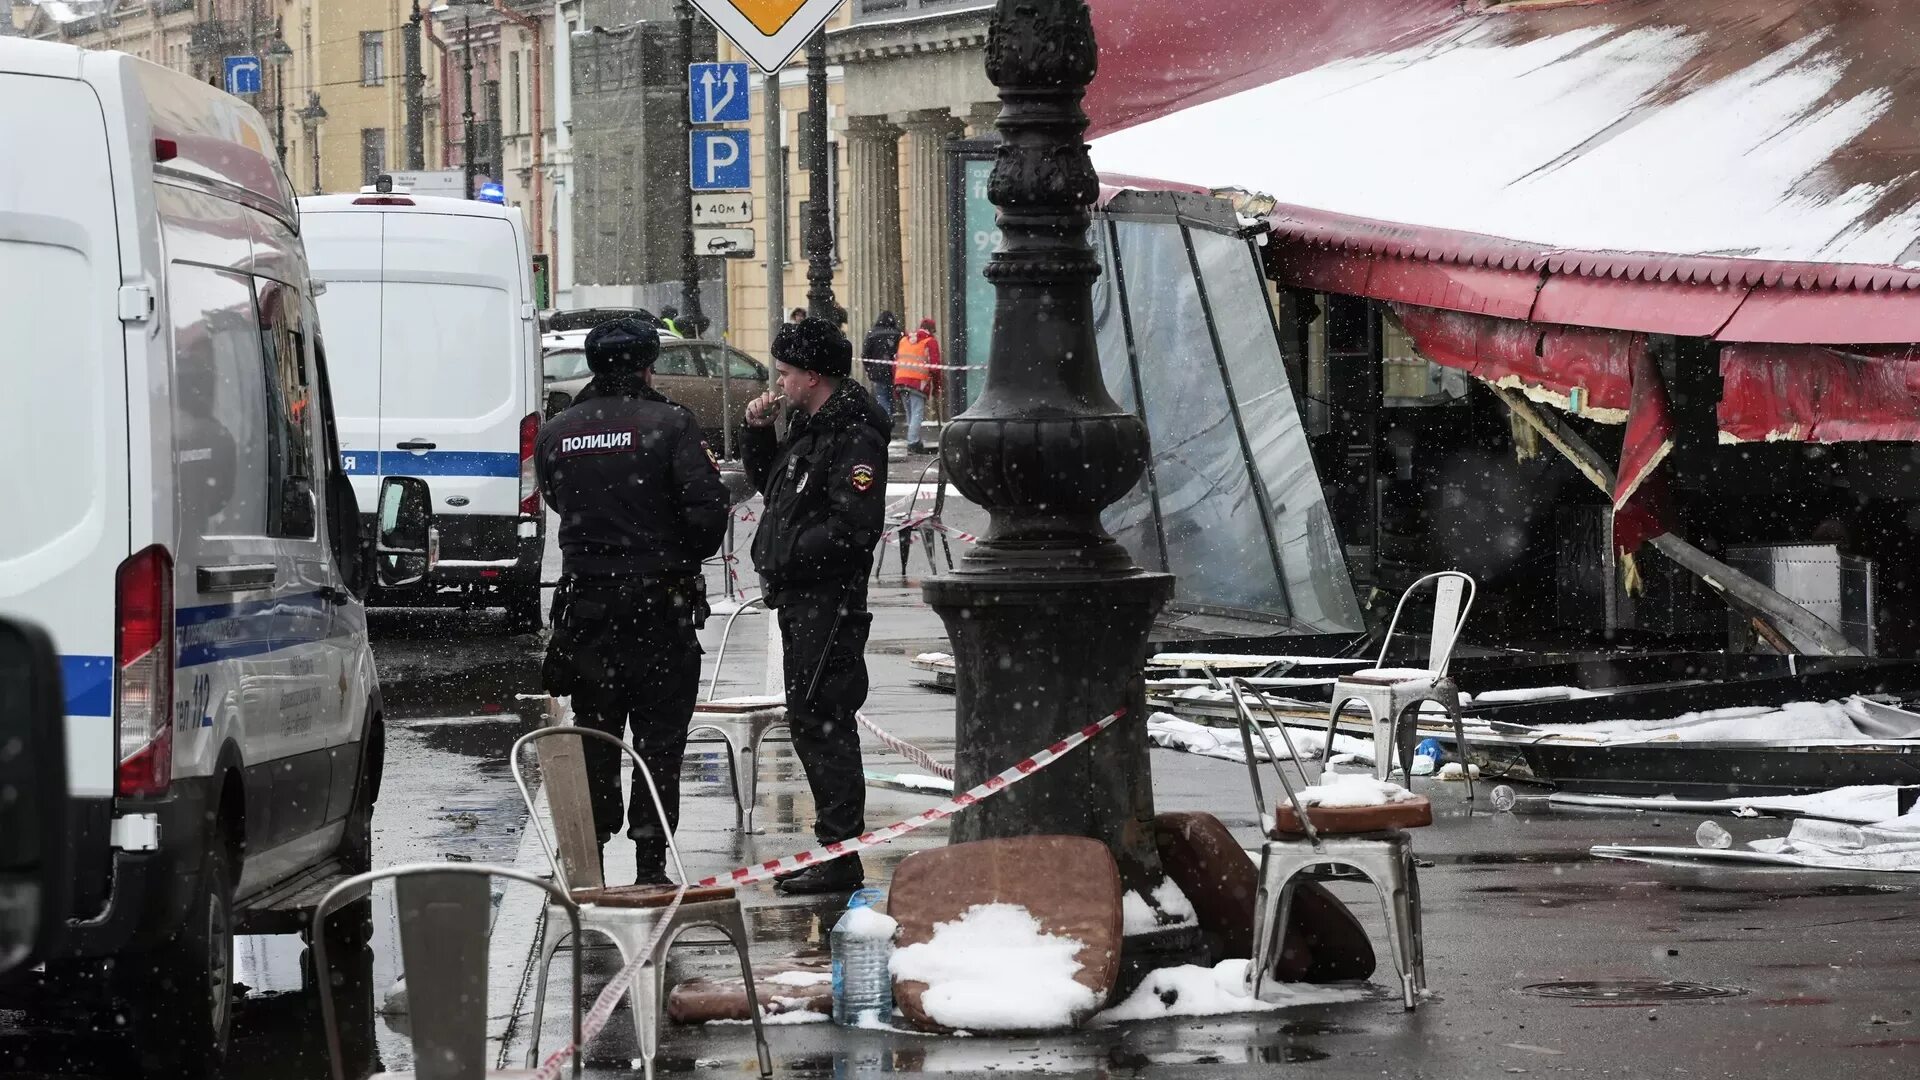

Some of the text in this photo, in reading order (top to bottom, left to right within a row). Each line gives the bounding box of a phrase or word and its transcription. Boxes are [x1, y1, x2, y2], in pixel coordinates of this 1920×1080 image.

[706, 136, 739, 183] P
[562, 432, 631, 452] ПОЛИЦИЯ
[192, 673, 213, 729] 112
